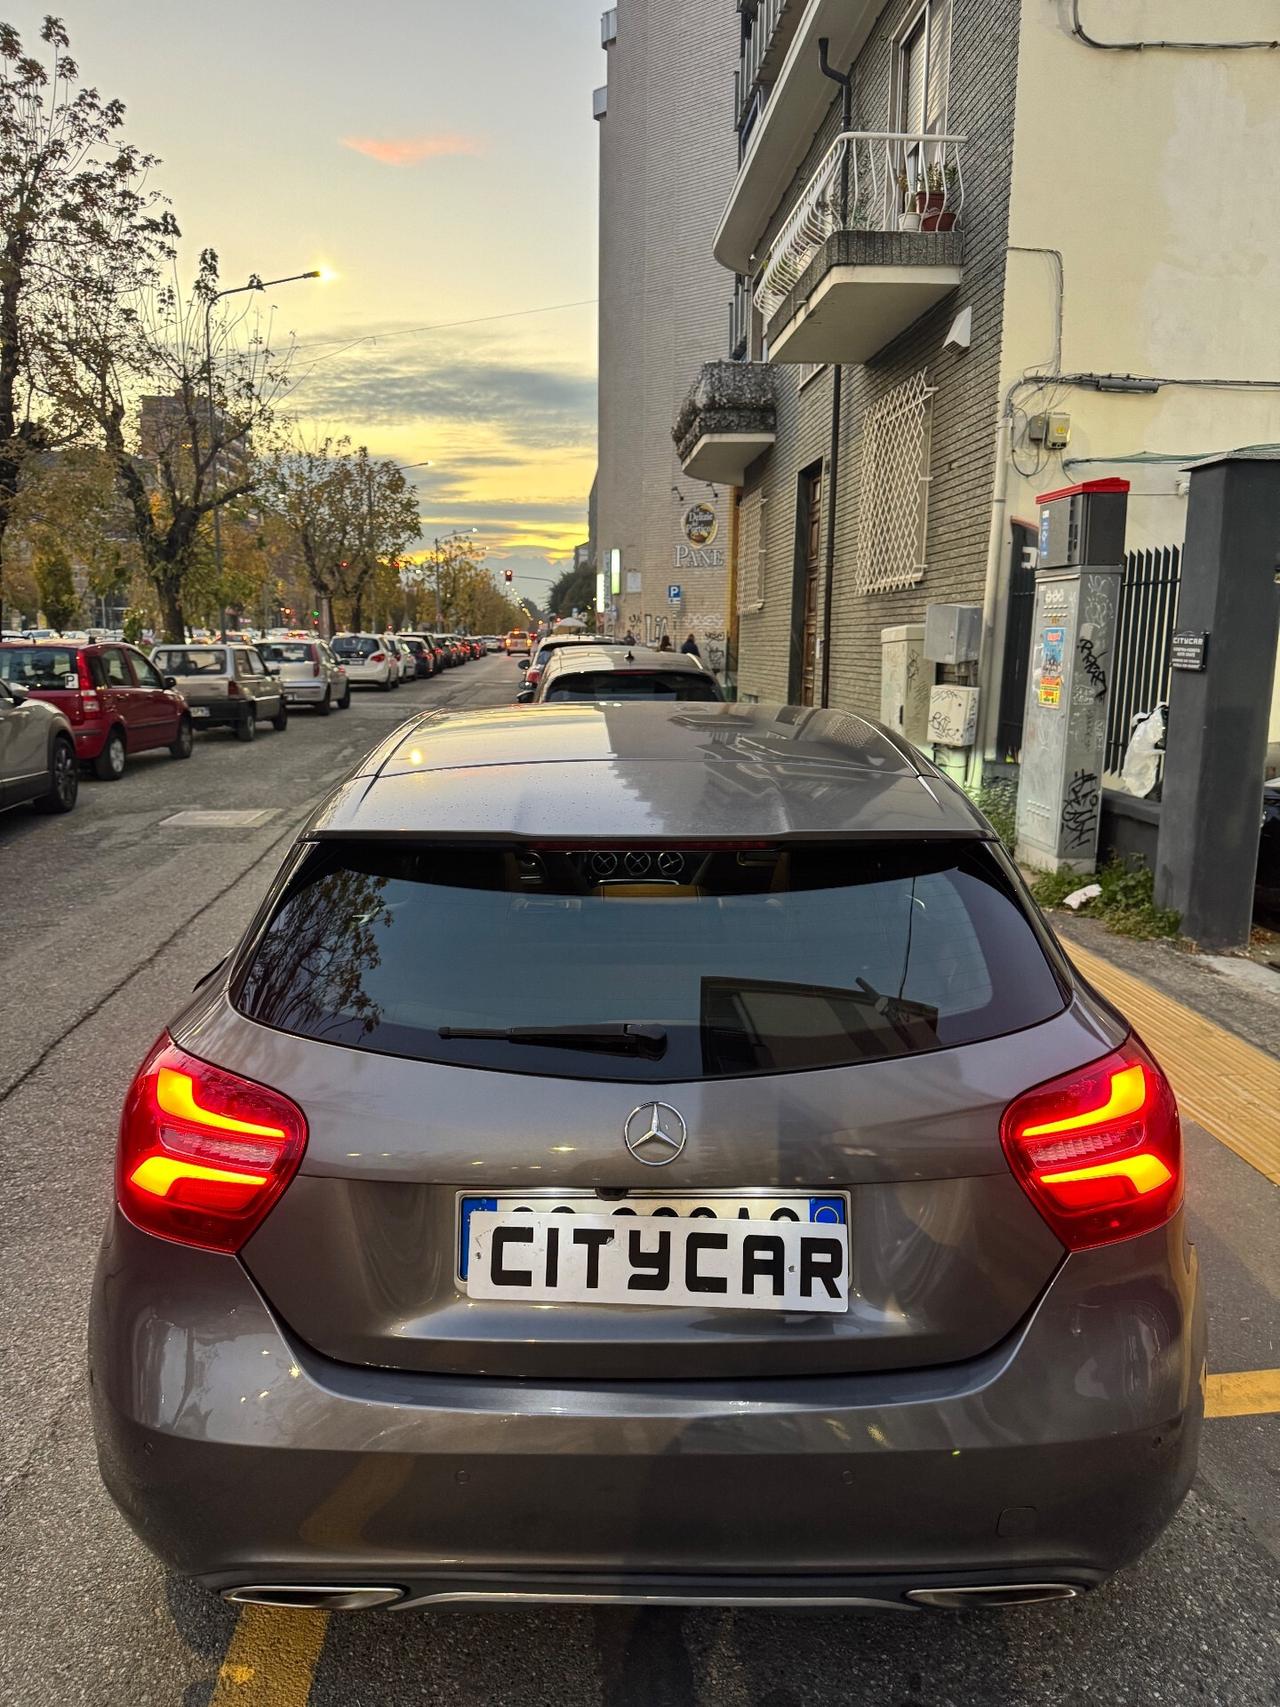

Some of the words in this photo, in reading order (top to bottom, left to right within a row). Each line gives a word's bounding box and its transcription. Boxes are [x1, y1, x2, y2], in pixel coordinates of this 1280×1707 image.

[675, 545, 723, 567] PANE
[670, 586, 679, 597] P
[1172, 637, 1204, 645] CITYCAR
[66, 674, 75, 686] P
[490, 1226, 843, 1299] CITYCAR
